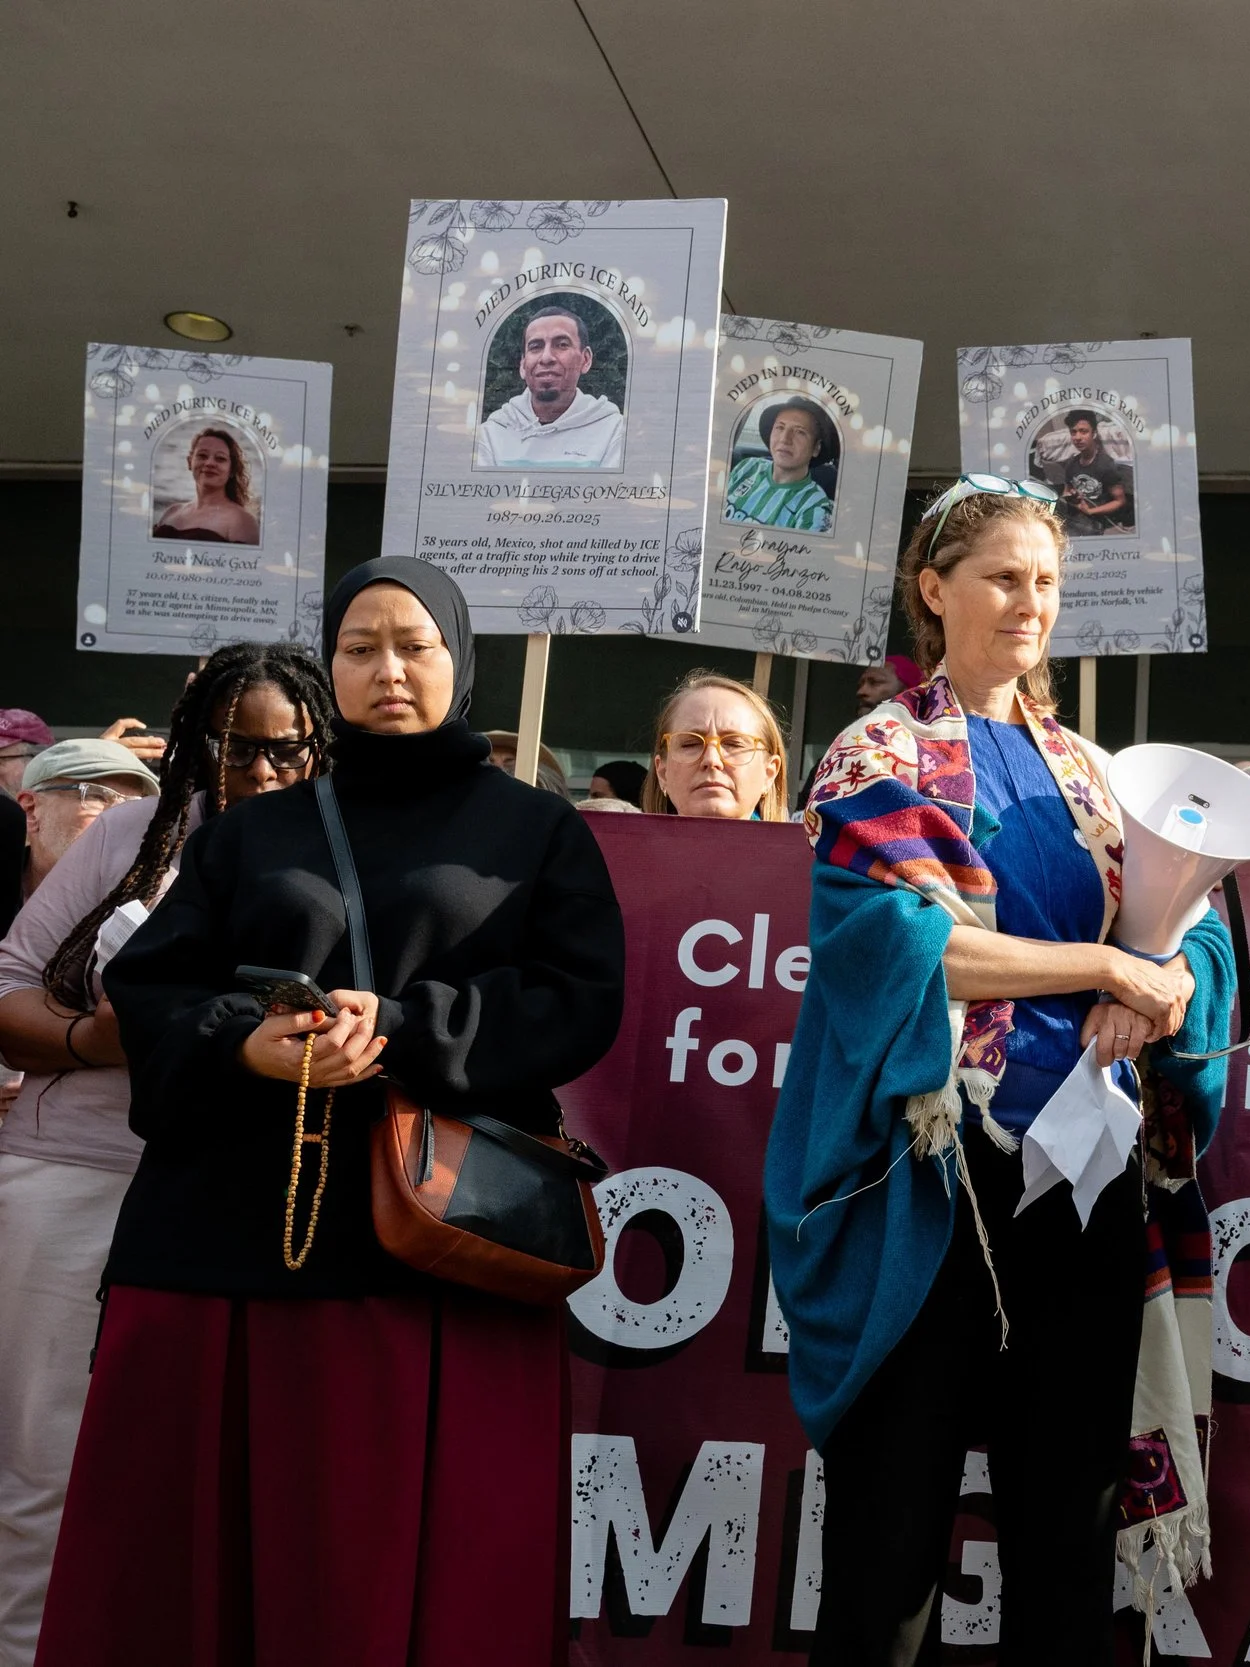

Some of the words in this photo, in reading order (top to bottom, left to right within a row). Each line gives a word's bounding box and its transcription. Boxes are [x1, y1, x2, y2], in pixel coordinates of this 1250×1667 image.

[475, 283, 511, 328] DIED
[514, 262, 585, 290] DURING
[590, 265, 617, 290] ICE
[618, 281, 648, 327] RAID
[727, 373, 759, 402] DIED
[761, 367, 777, 380] IN
[782, 366, 854, 416] DETENTION
[1015, 405, 1040, 440] DIED
[1041, 387, 1092, 410] DURING
[1095, 389, 1117, 406] ICE
[1118, 400, 1144, 433] RAID
[144, 409, 171, 440] DIED
[172, 397, 227, 415] DURING
[230, 402, 251, 419] ICE
[252, 416, 277, 450] RAID
[424, 483, 500, 498] SILVERIO
[504, 484, 580, 503] VILLEGAS
[583, 483, 667, 503] GONZALES
[486, 510, 600, 526] 1987-09.26.2025
[422, 536, 437, 546] 38
[438, 539, 468, 549] years
[471, 537, 491, 549] old,
[494, 538, 536, 550] Mexico,
[539, 538, 563, 549] shot
[566, 539, 588, 549] and
[590, 539, 622, 549] killed
[624, 539, 637, 552] by
[640, 540, 661, 550] ICE
[192, 552, 227, 568] Nicole
[229, 556, 262, 572] Good
[419, 551, 458, 561] agents,
[461, 552, 472, 561] at
[476, 553, 483, 561] a
[486, 551, 520, 563] traffic
[523, 552, 546, 564] stop
[550, 552, 579, 563] while
[582, 553, 616, 565] trying
[618, 554, 630, 563] to
[632, 553, 660, 563] drive
[1063, 549, 1141, 562] astro-Rivera
[450, 563, 477, 575] after
[479, 563, 530, 577] dropping
[532, 564, 549, 575] his
[551, 565, 559, 576] 2
[561, 567, 586, 576] sons
[589, 565, 606, 578] off
[606, 567, 618, 576] at
[621, 566, 659, 577] school.
[709, 578, 762, 593] 11.23.1997
[772, 587, 831, 601] 04.08.2025
[1100, 588, 1125, 597] struck
[1126, 587, 1136, 597] by
[1137, 586, 1164, 595] vehicle
[125, 598, 136, 607] by
[152, 600, 166, 608] ICE
[169, 602, 192, 611] agent
[194, 602, 203, 610] in
[139, 591, 162, 600] years
[260, 597, 279, 606] shot
[771, 600, 788, 609] Held
[790, 602, 796, 610] in
[1075, 599, 1089, 607] ICE
[1091, 599, 1099, 607] in
[138, 608, 151, 616] she
[172, 611, 218, 621] attempting
[230, 614, 251, 623] drive
[677, 913, 812, 992] Cle
